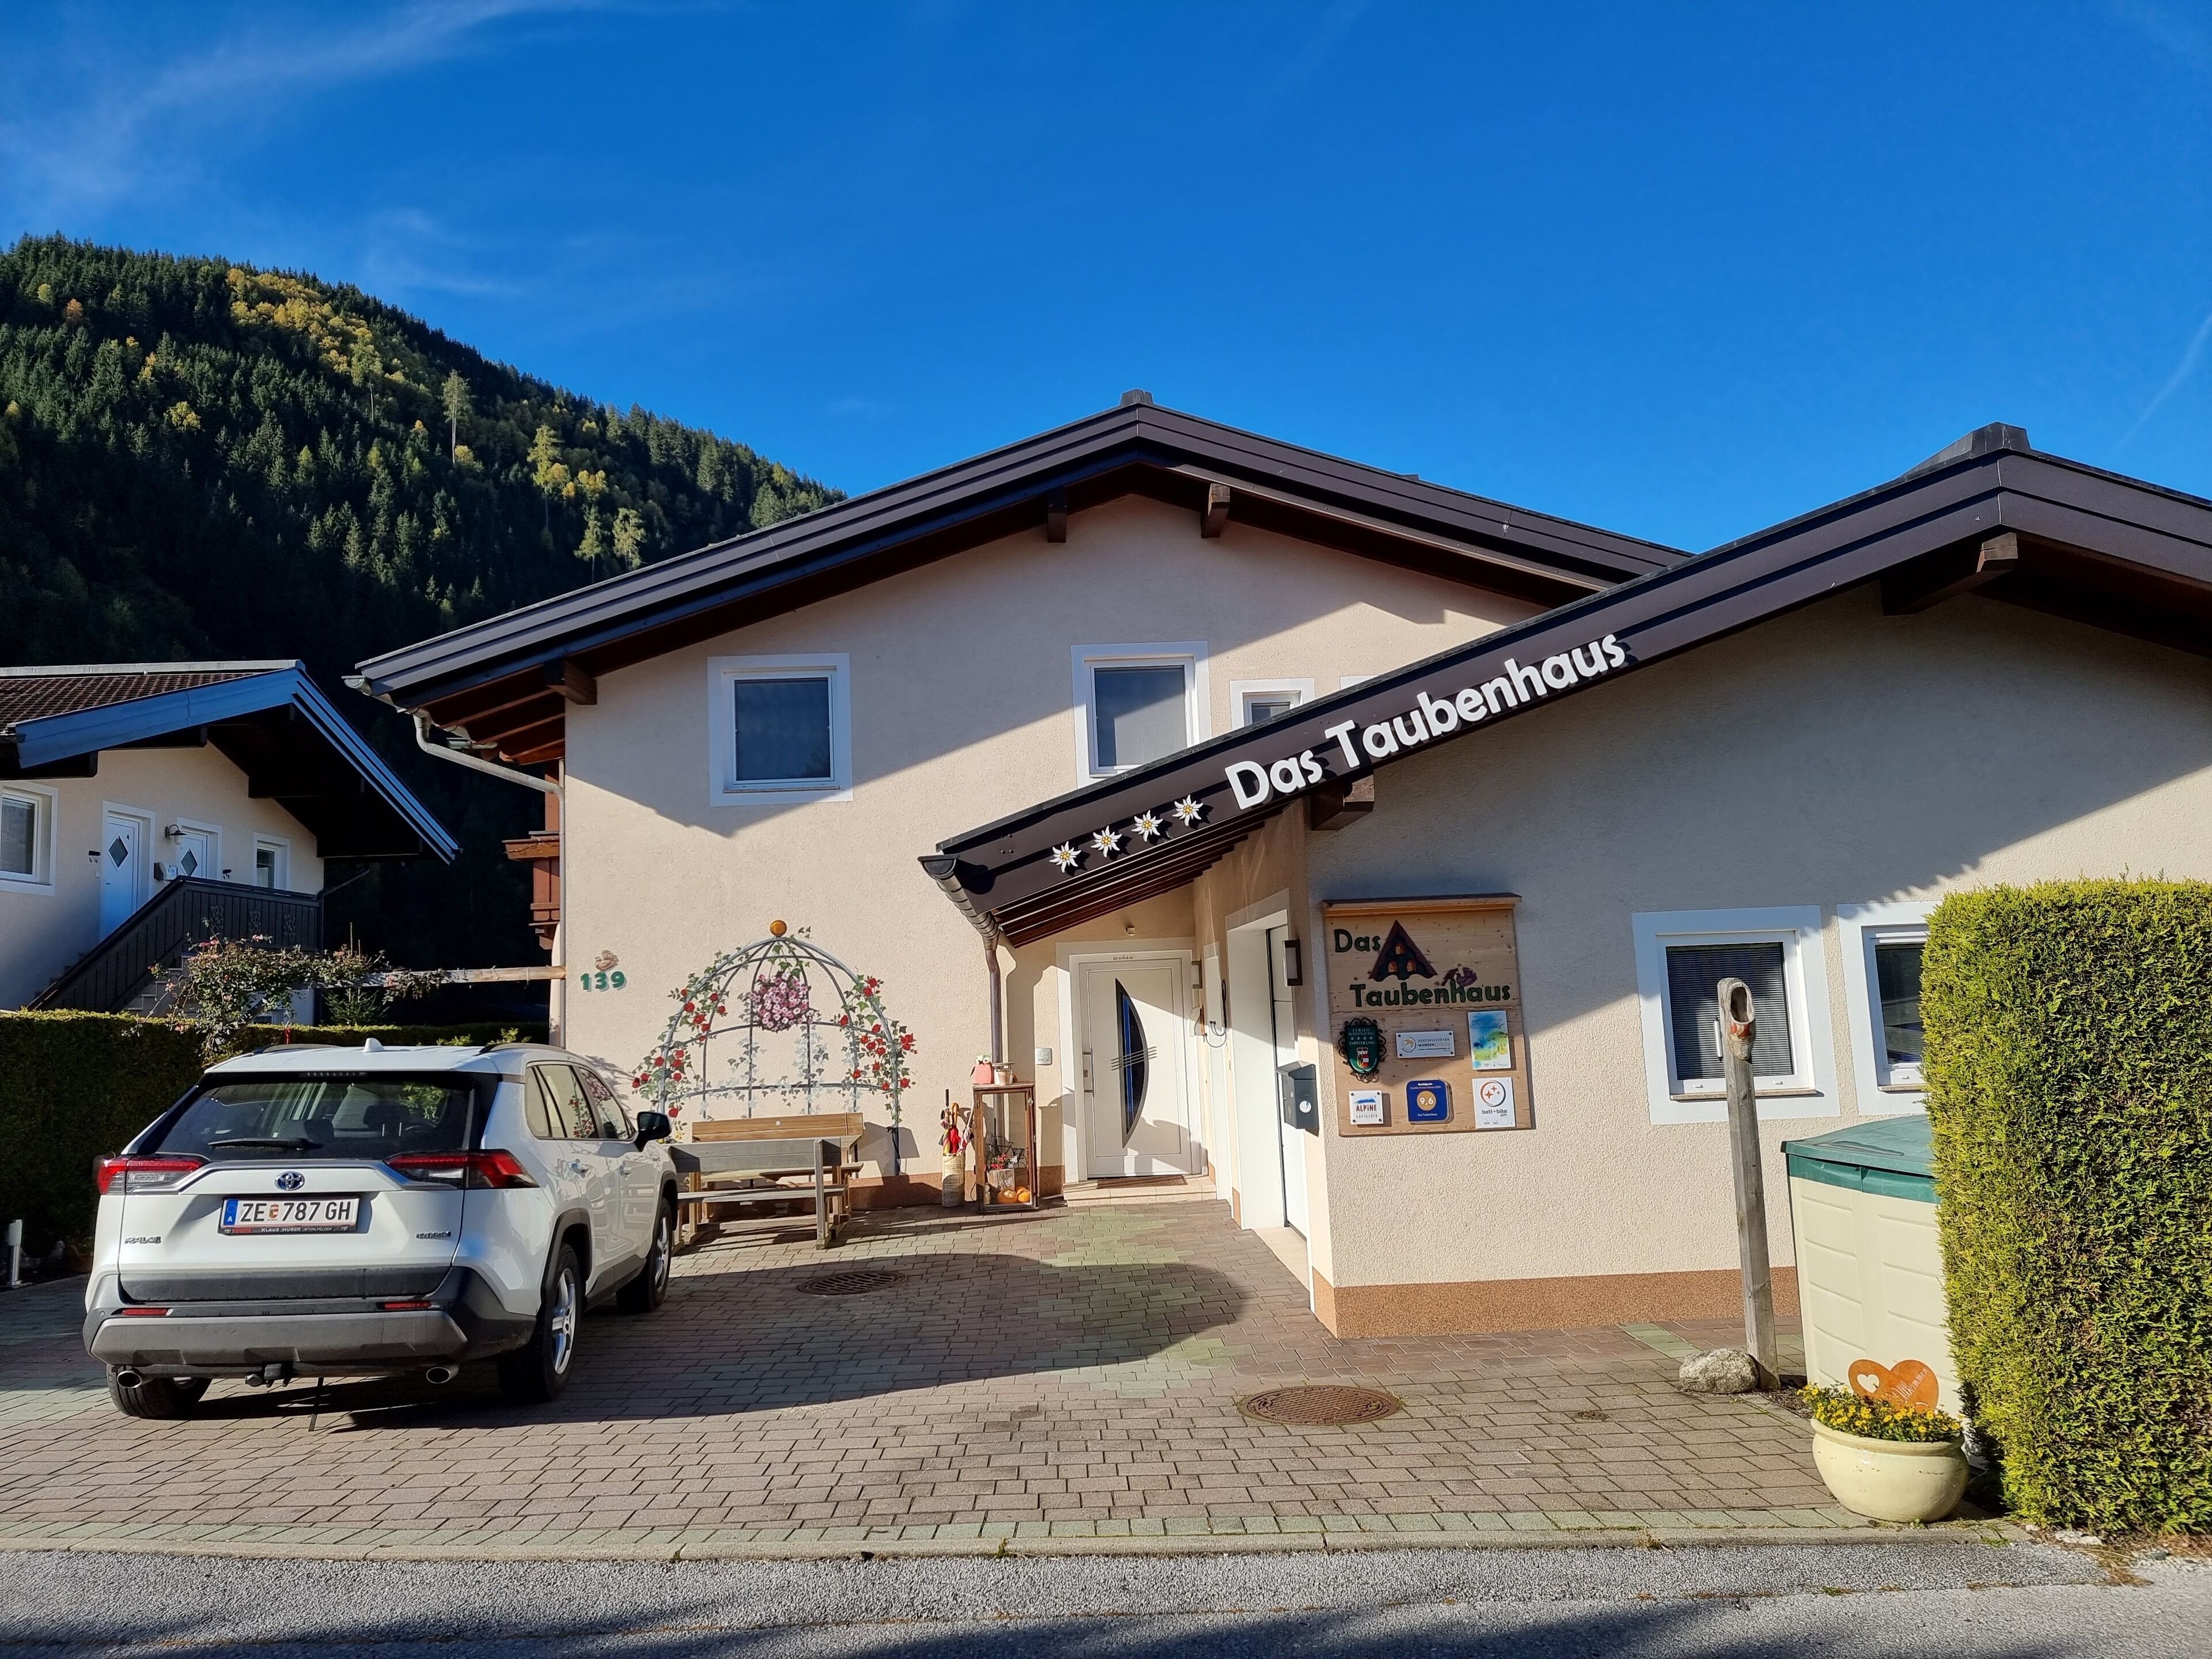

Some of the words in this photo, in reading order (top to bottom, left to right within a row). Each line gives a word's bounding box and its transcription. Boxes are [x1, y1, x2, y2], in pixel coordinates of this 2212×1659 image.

[1225, 749, 1323, 809] Das
[1325, 634, 1626, 768] Taubenhaus
[1334, 929, 1381, 953] Das
[579, 971, 626, 990] 139
[1349, 979, 1511, 1007] Taubenhaus
[1419, 1097, 1434, 1106] 9,6
[240, 1203, 267, 1222] ZE
[282, 1202, 320, 1221] 787
[325, 1202, 351, 1221] GH
